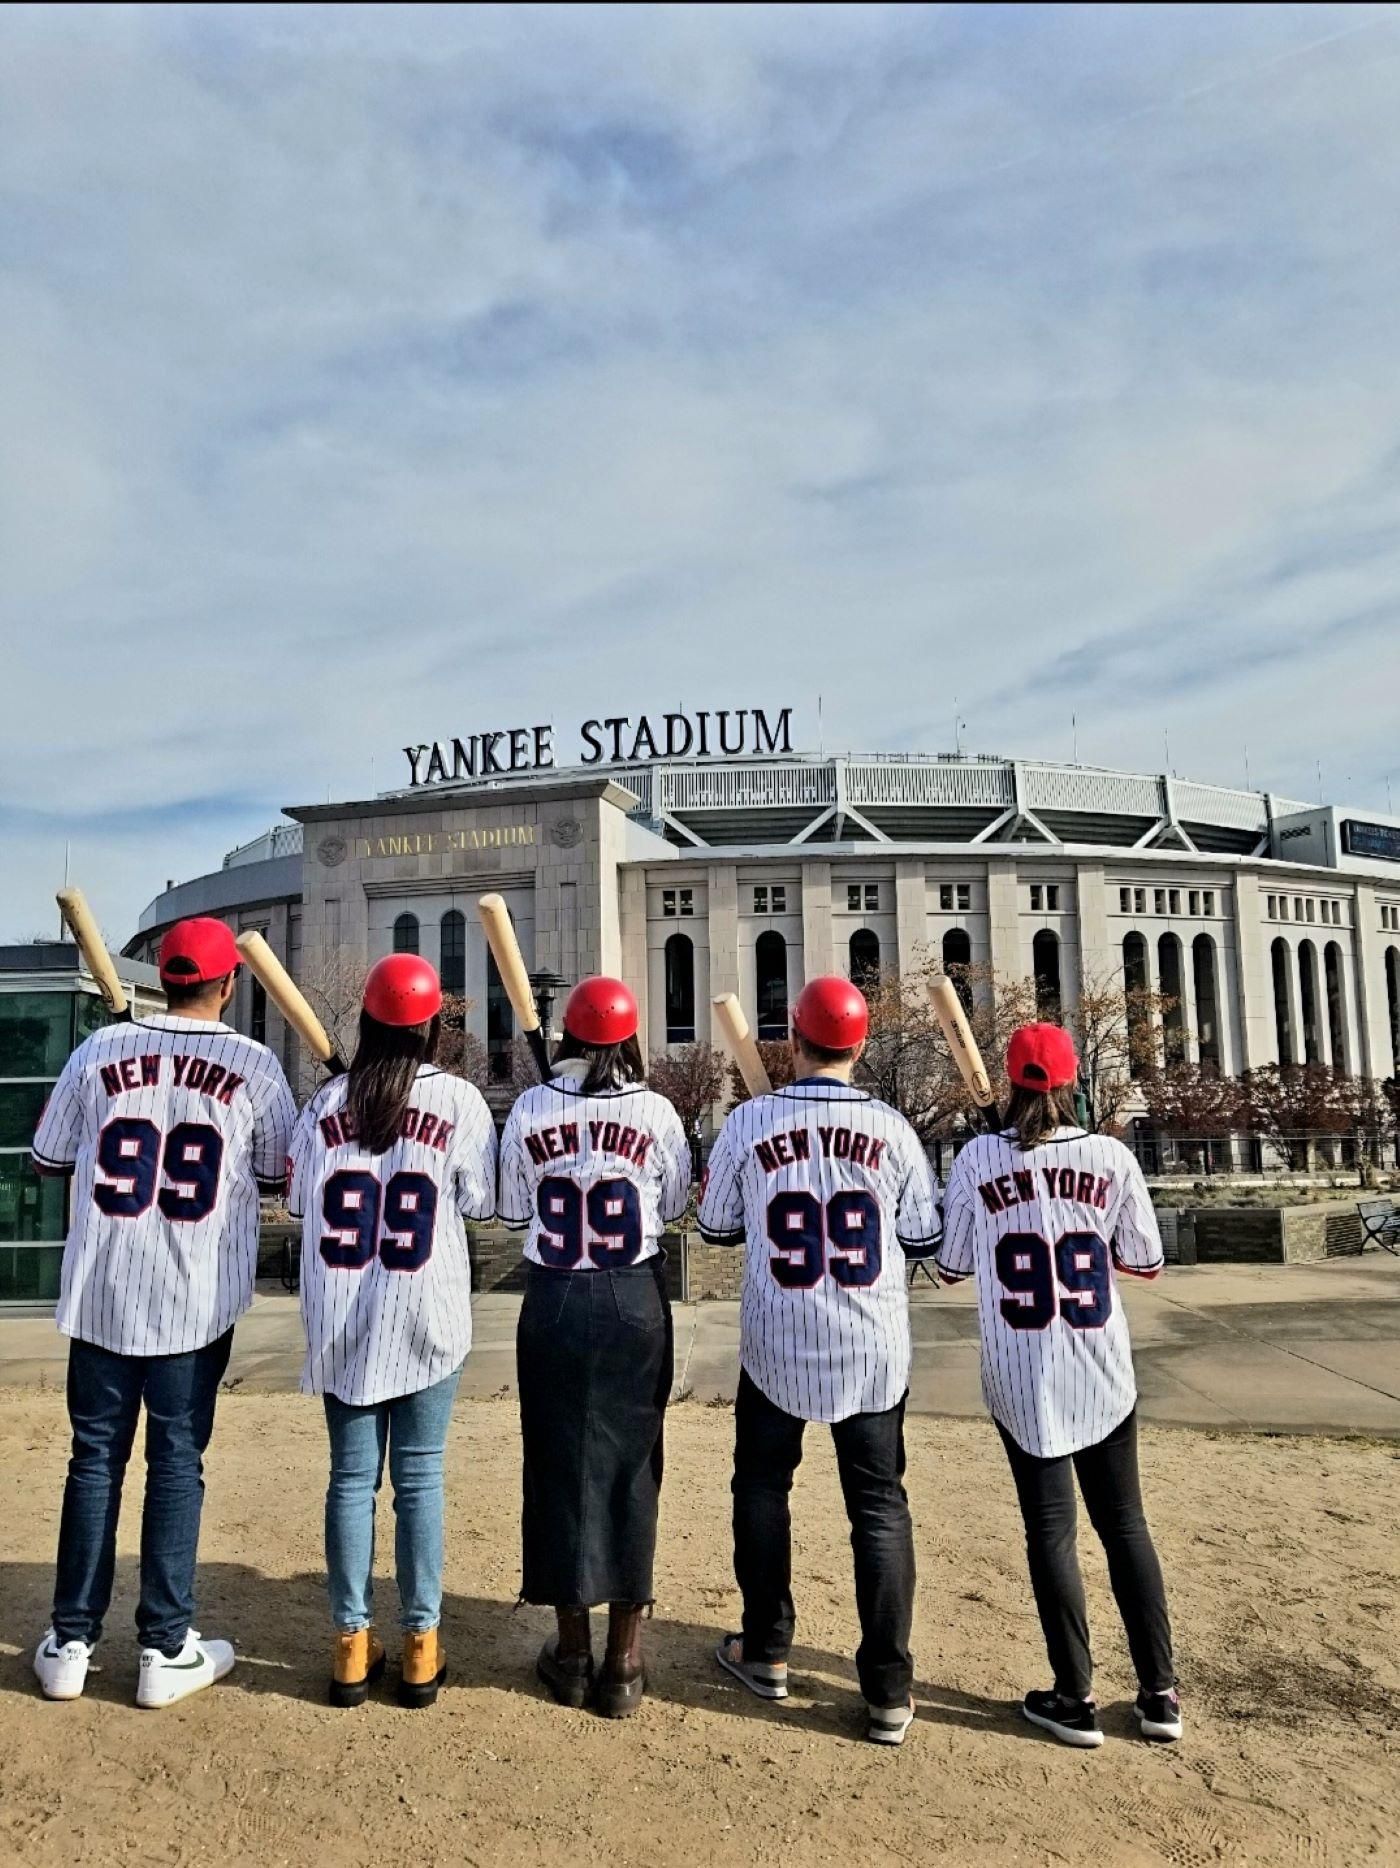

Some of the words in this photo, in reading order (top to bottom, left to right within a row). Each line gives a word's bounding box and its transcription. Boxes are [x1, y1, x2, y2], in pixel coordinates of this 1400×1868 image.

[402, 725, 555, 787] YANKEE
[580, 708, 793, 763] STADIUM
[364, 833, 438, 857] YANKEE
[448, 826, 534, 849] STADIUM
[100, 1055, 161, 1097] NEW
[173, 1055, 244, 1105] YORK
[400, 1107, 455, 1153] ORK
[524, 1122, 579, 1166] NEW
[589, 1121, 654, 1167] YORK
[754, 1127, 809, 1173] NEW
[818, 1127, 887, 1170] YORK
[94, 1117, 224, 1222] 99
[977, 1169, 1034, 1215] NEW
[1042, 1168, 1112, 1210] YORK
[319, 1169, 438, 1272] 99
[537, 1176, 642, 1269] 99
[767, 1190, 882, 1289] 99
[995, 1231, 1113, 1330] 99
